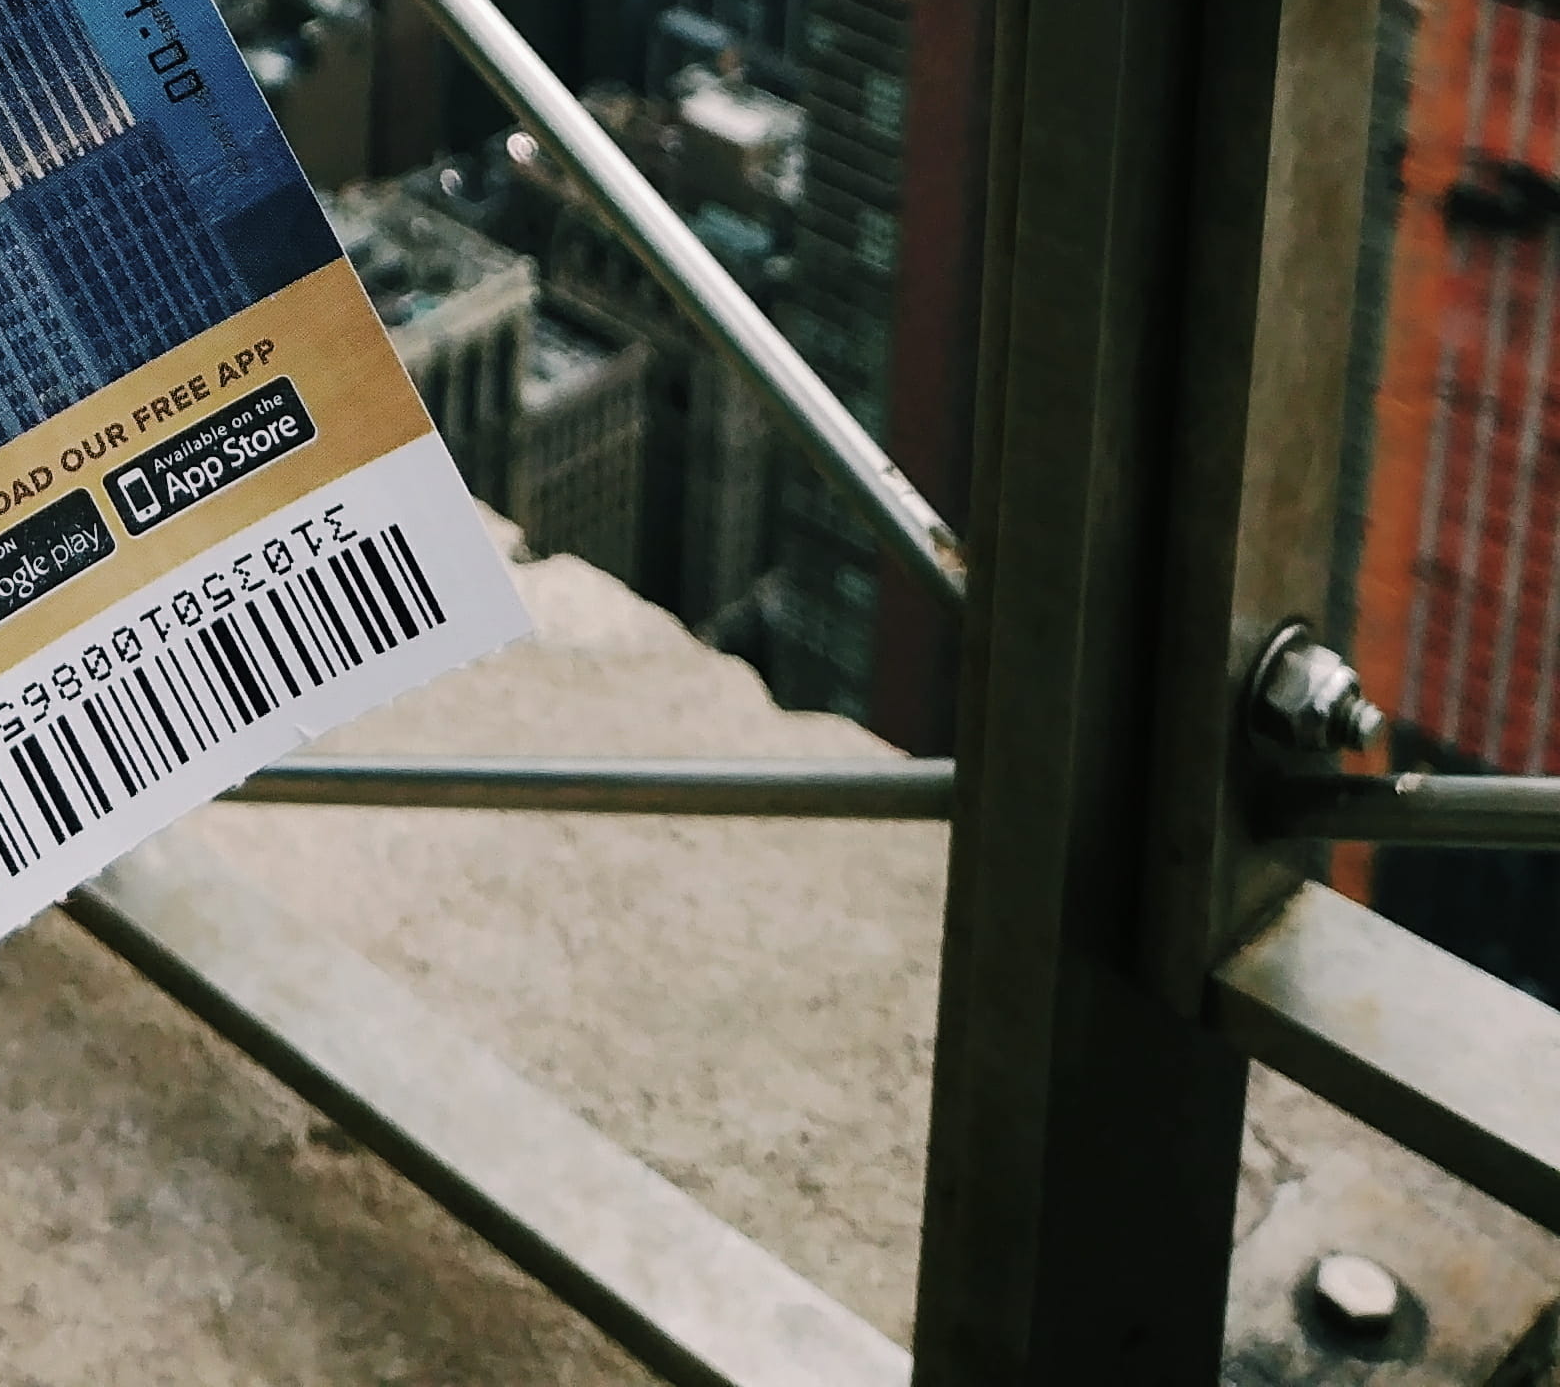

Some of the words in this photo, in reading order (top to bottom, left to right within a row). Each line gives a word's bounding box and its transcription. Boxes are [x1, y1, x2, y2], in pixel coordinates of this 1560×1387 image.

[60, 422, 129, 473] OUR
[132, 374, 211, 433] FREE
[217, 338, 276, 388] APP
[152, 424, 227, 474] Available
[231, 408, 253, 430] on
[254, 391, 283, 417] the
[164, 452, 223, 504] App
[223, 412, 299, 468] Store
[50, 522, 100, 571] play
